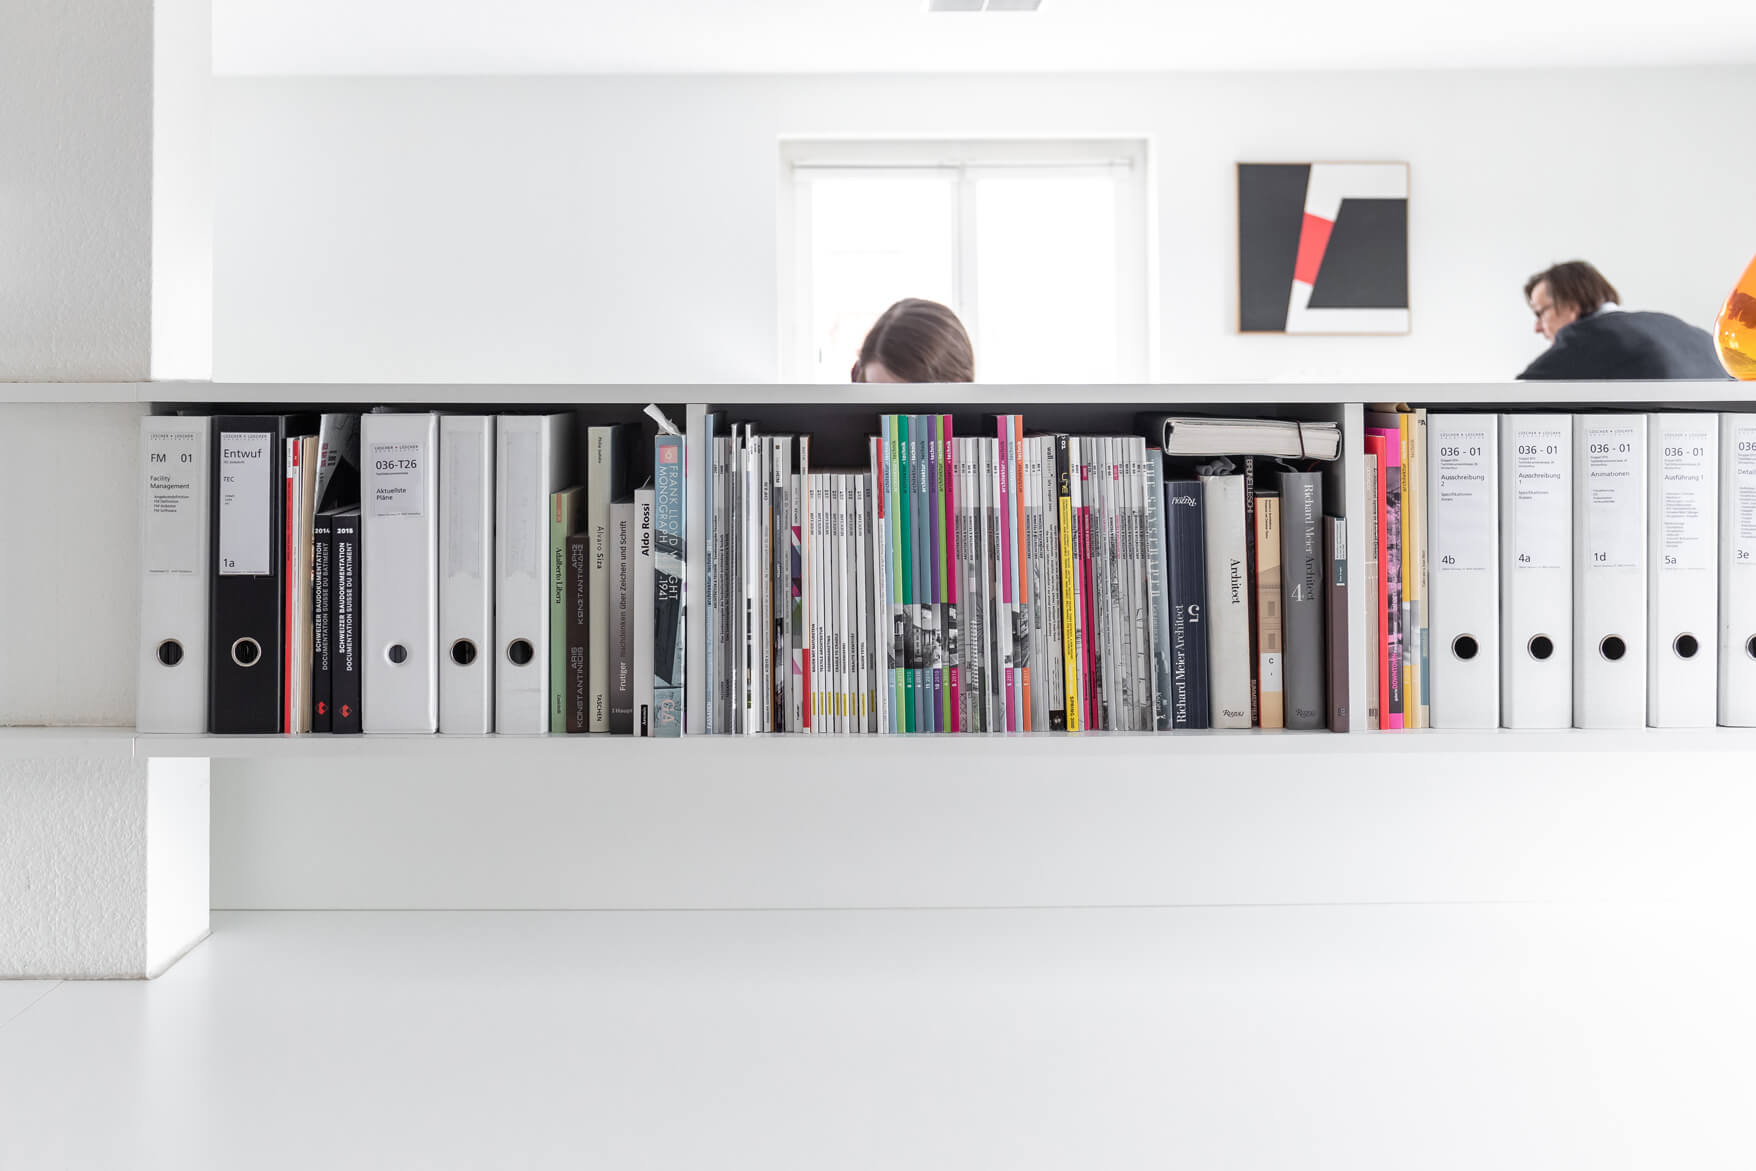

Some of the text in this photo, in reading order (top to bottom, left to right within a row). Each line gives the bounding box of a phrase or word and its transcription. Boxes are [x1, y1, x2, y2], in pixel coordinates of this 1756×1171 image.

[1440, 447, 1460, 456] 036
[1470, 447, 1481, 456] 01
[1518, 445, 1537, 455] 036
[1546, 445, 1558, 455] 01
[1590, 444, 1609, 453] 036
[1619, 444, 1630, 453] 01
[1664, 447, 1683, 456] 036
[1692, 447, 1704, 456] 01
[1738, 442, 1756, 451] 036
[150, 453, 192, 463] FM 01
[224, 448, 262, 458] Entwuf
[376, 459, 417, 470] 036-T26
[658, 466, 667, 543] MONOGRAPH
[642, 503, 650, 556] Aldo Rossi
[668, 465, 678, 600] FRANK LLOYD WGHT
[1304, 484, 1315, 601] Richard Meier Architect
[1518, 553, 1530, 562] 4a
[1594, 552, 1606, 561] 1d
[1737, 549, 1749, 559] 3e
[224, 558, 234, 568] 1a
[1442, 555, 1455, 564] 4b
[1664, 555, 1676, 564] 5a
[322, 578, 329, 587] DU
[346, 578, 352, 587] DU
[1230, 559, 1241, 604] Architect
[1291, 584, 1303, 601] 4
[1187, 604, 1200, 622] 5
[1175, 604, 1187, 722] Richard Meier Architect
[619, 662, 628, 691] Frutiger
